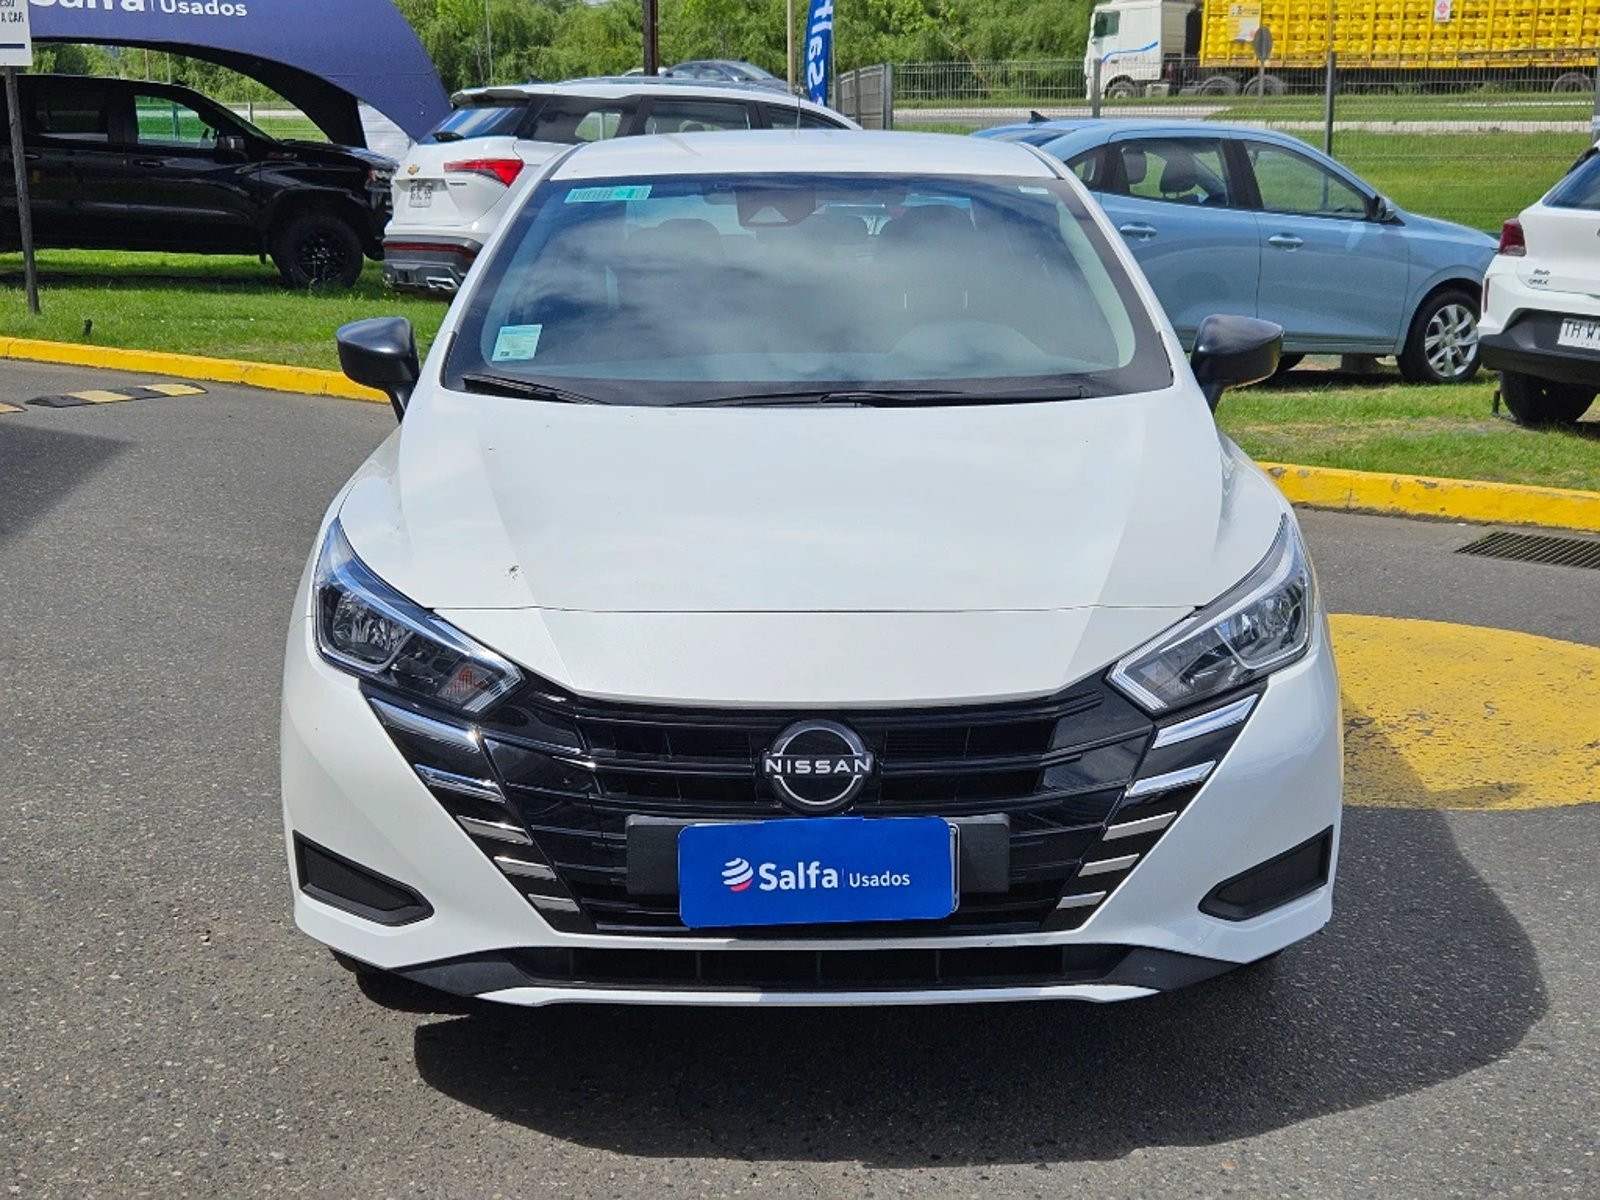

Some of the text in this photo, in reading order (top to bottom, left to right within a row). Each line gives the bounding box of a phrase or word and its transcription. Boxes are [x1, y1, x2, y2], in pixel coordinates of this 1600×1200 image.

[160, 0, 248, 17] Usados
[765, 758, 871, 774] NISSAN
[758, 860, 911, 891] Salfa Usados
